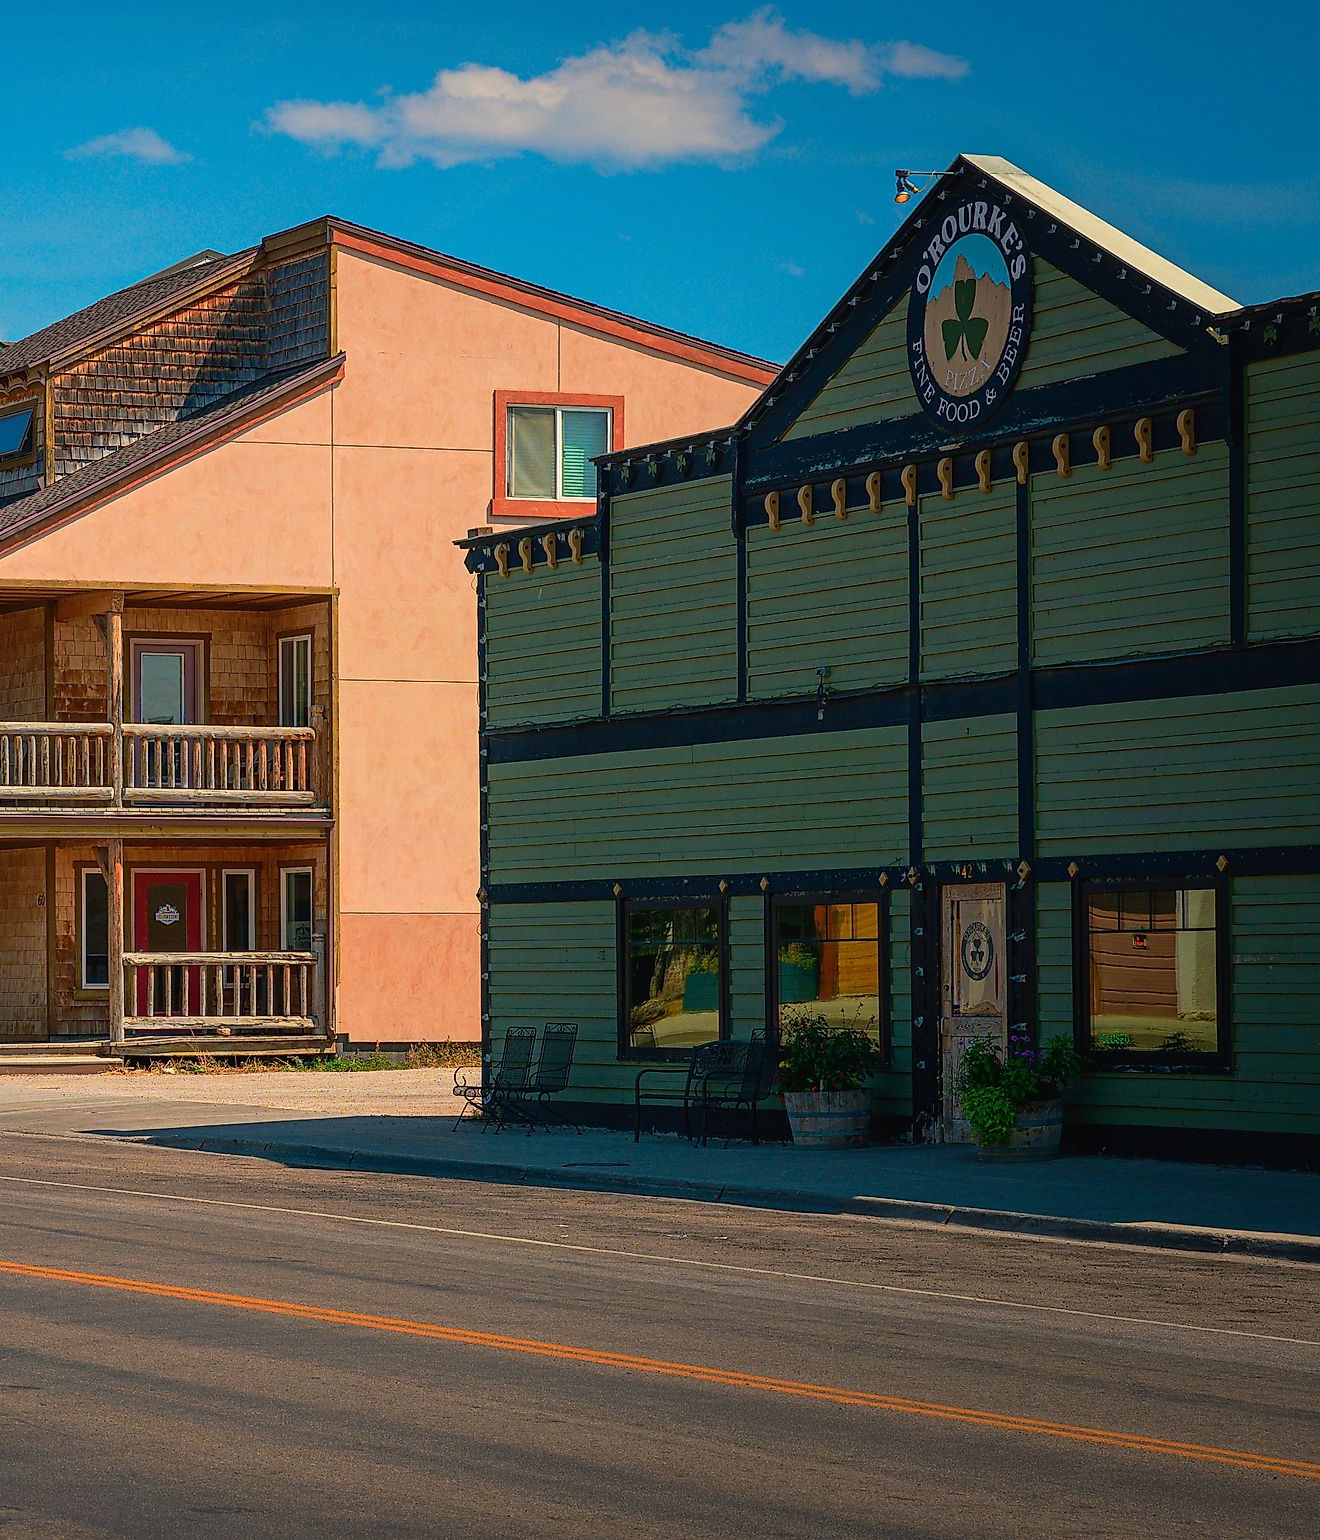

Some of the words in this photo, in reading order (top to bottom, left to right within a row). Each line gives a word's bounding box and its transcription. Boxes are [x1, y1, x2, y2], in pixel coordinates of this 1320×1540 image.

[916, 201, 1026, 294] O'ROURKE'S
[912, 337, 935, 404] FINE
[936, 398, 981, 423] FOOD
[985, 387, 997, 405] &
[995, 302, 1025, 387] BEER
[944, 360, 991, 390] PIZZA
[961, 864, 973, 879] 42
